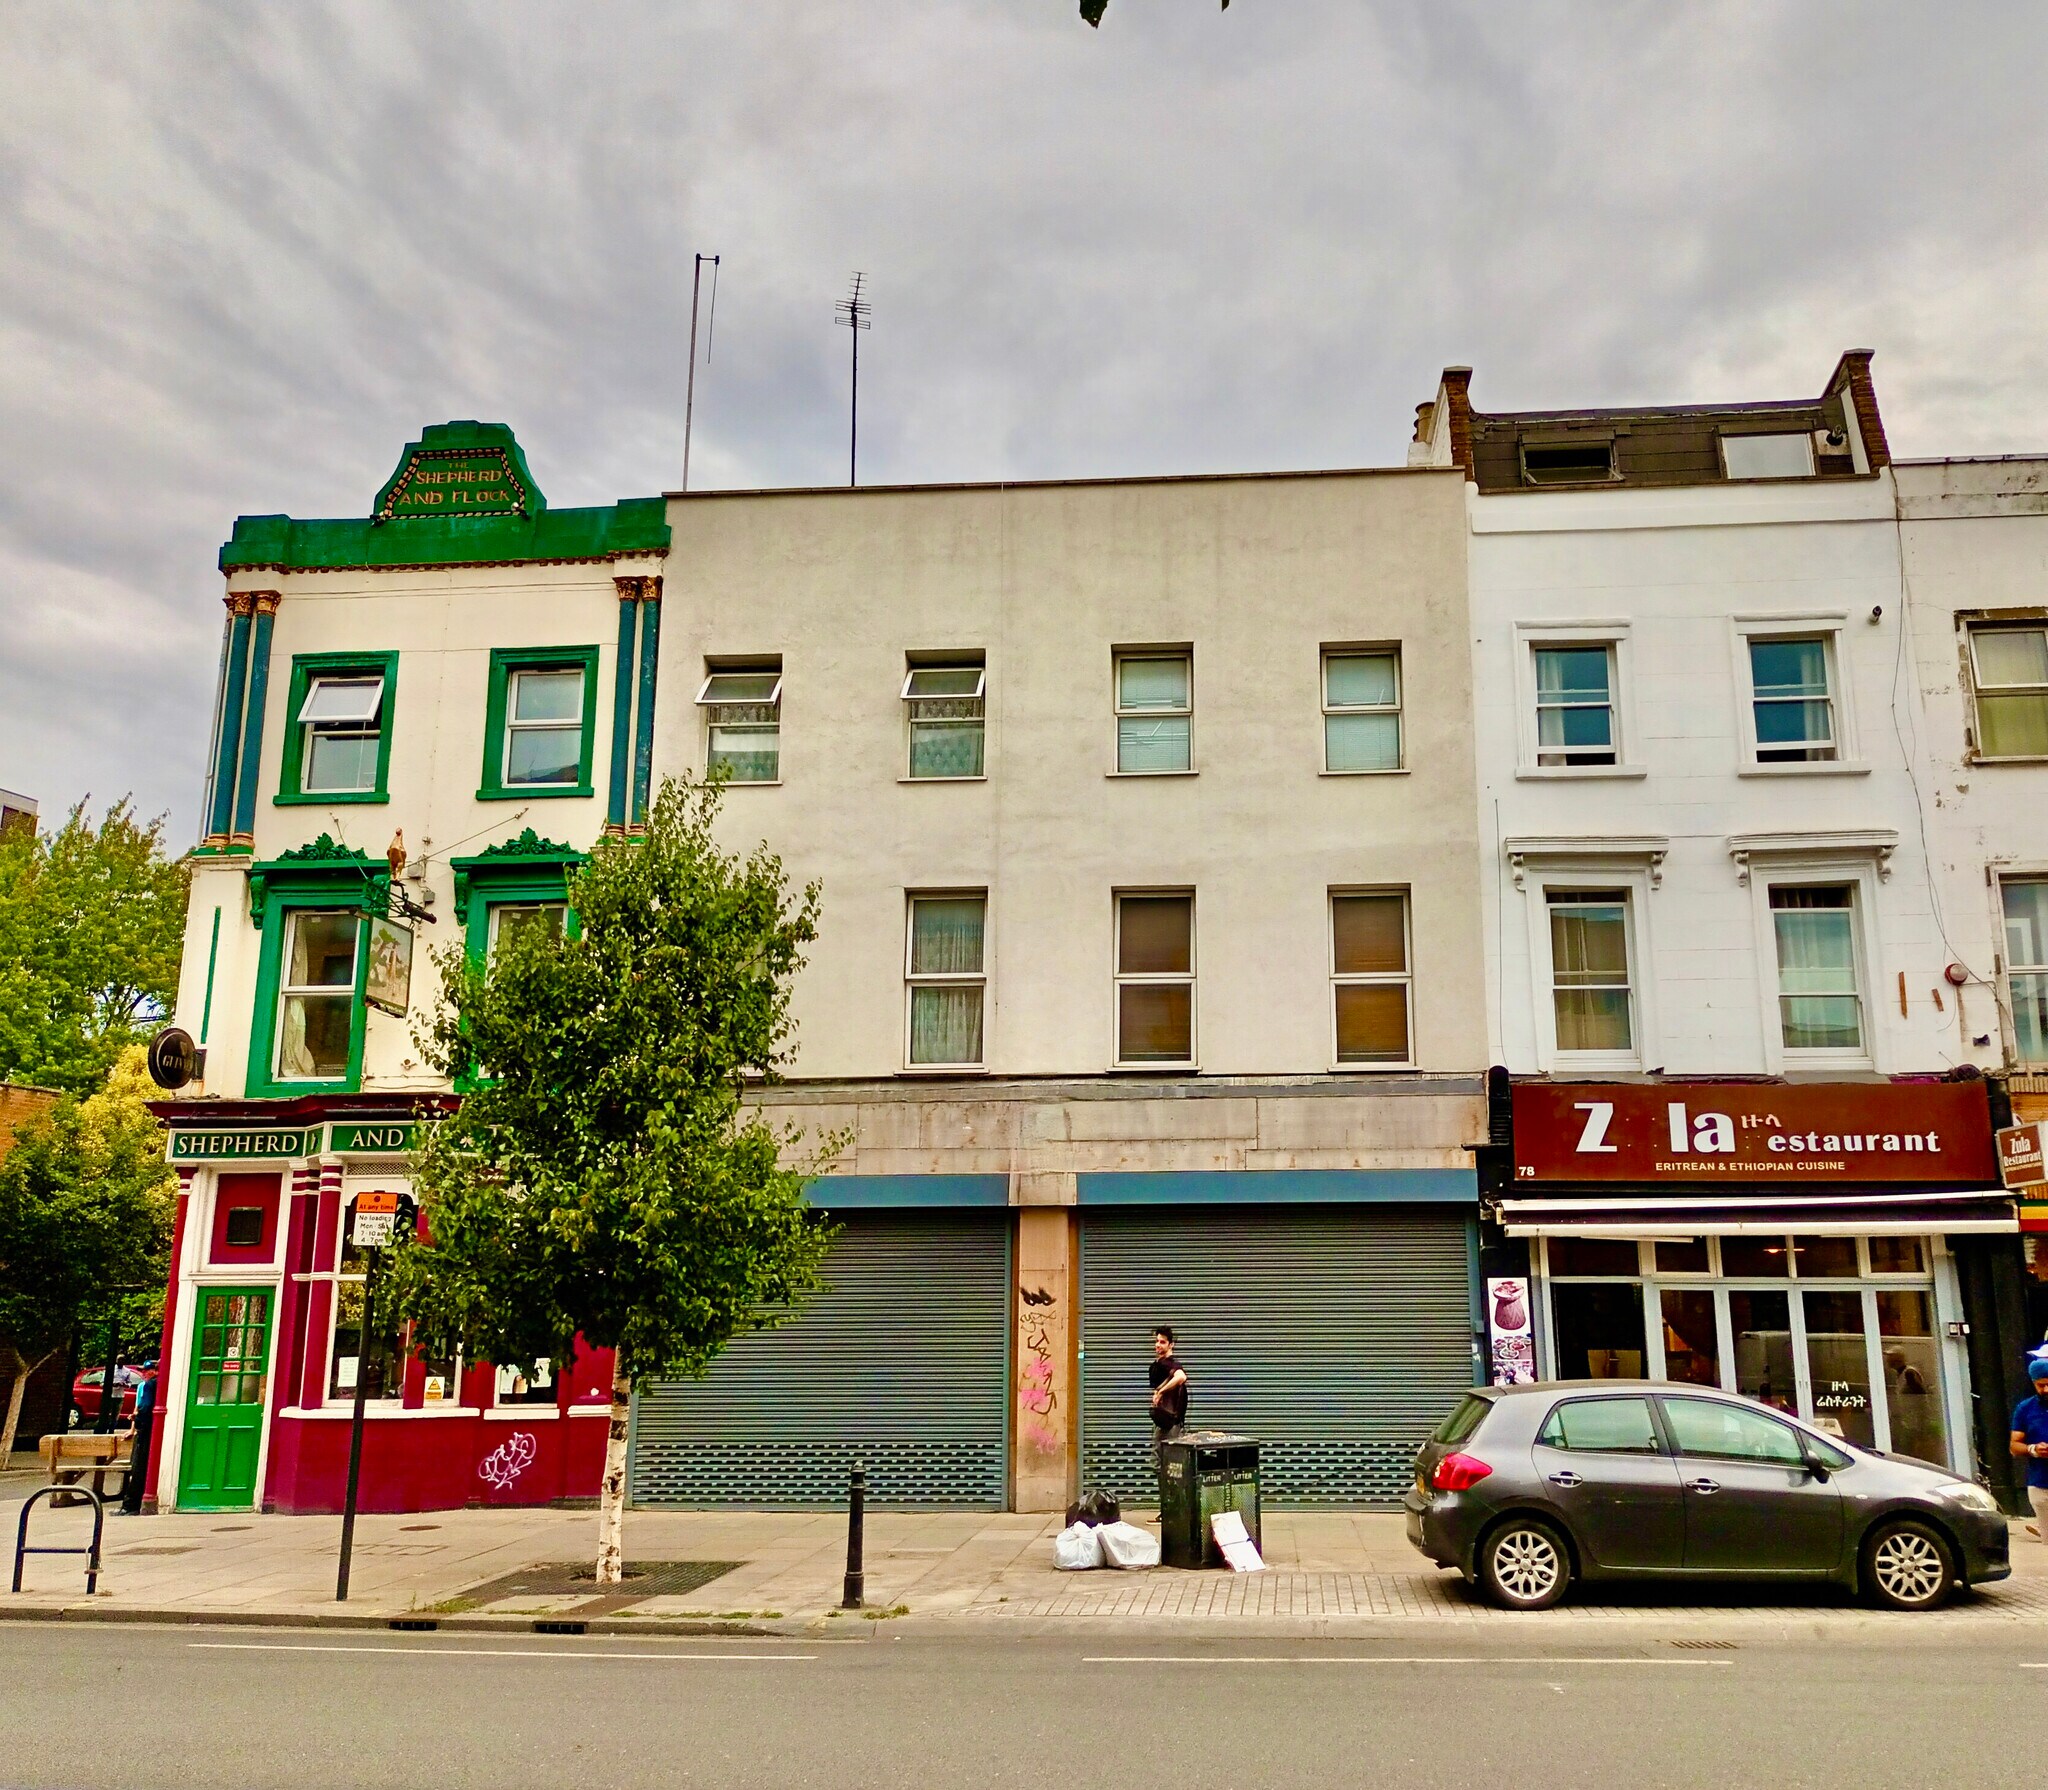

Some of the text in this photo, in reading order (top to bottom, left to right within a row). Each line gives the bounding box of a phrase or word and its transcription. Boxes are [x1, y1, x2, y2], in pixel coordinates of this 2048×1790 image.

[415, 470, 502, 485] SHEPHERD
[399, 489, 510, 505] AND FLOCK
[177, 1135, 298, 1154] SHEPHERD
[350, 1129, 404, 1147] AND
[2010, 1136, 2031, 1155] Zula
[1655, 1161, 1846, 1171] ERITREAN & ETHIOPIAN CUISINE
[2003, 1151, 2042, 1167] Restaurant
[1518, 1166, 1535, 1177] 78
[1202, 1473, 1222, 1482] LITTER
[1234, 1471, 1253, 1480] LITTER
